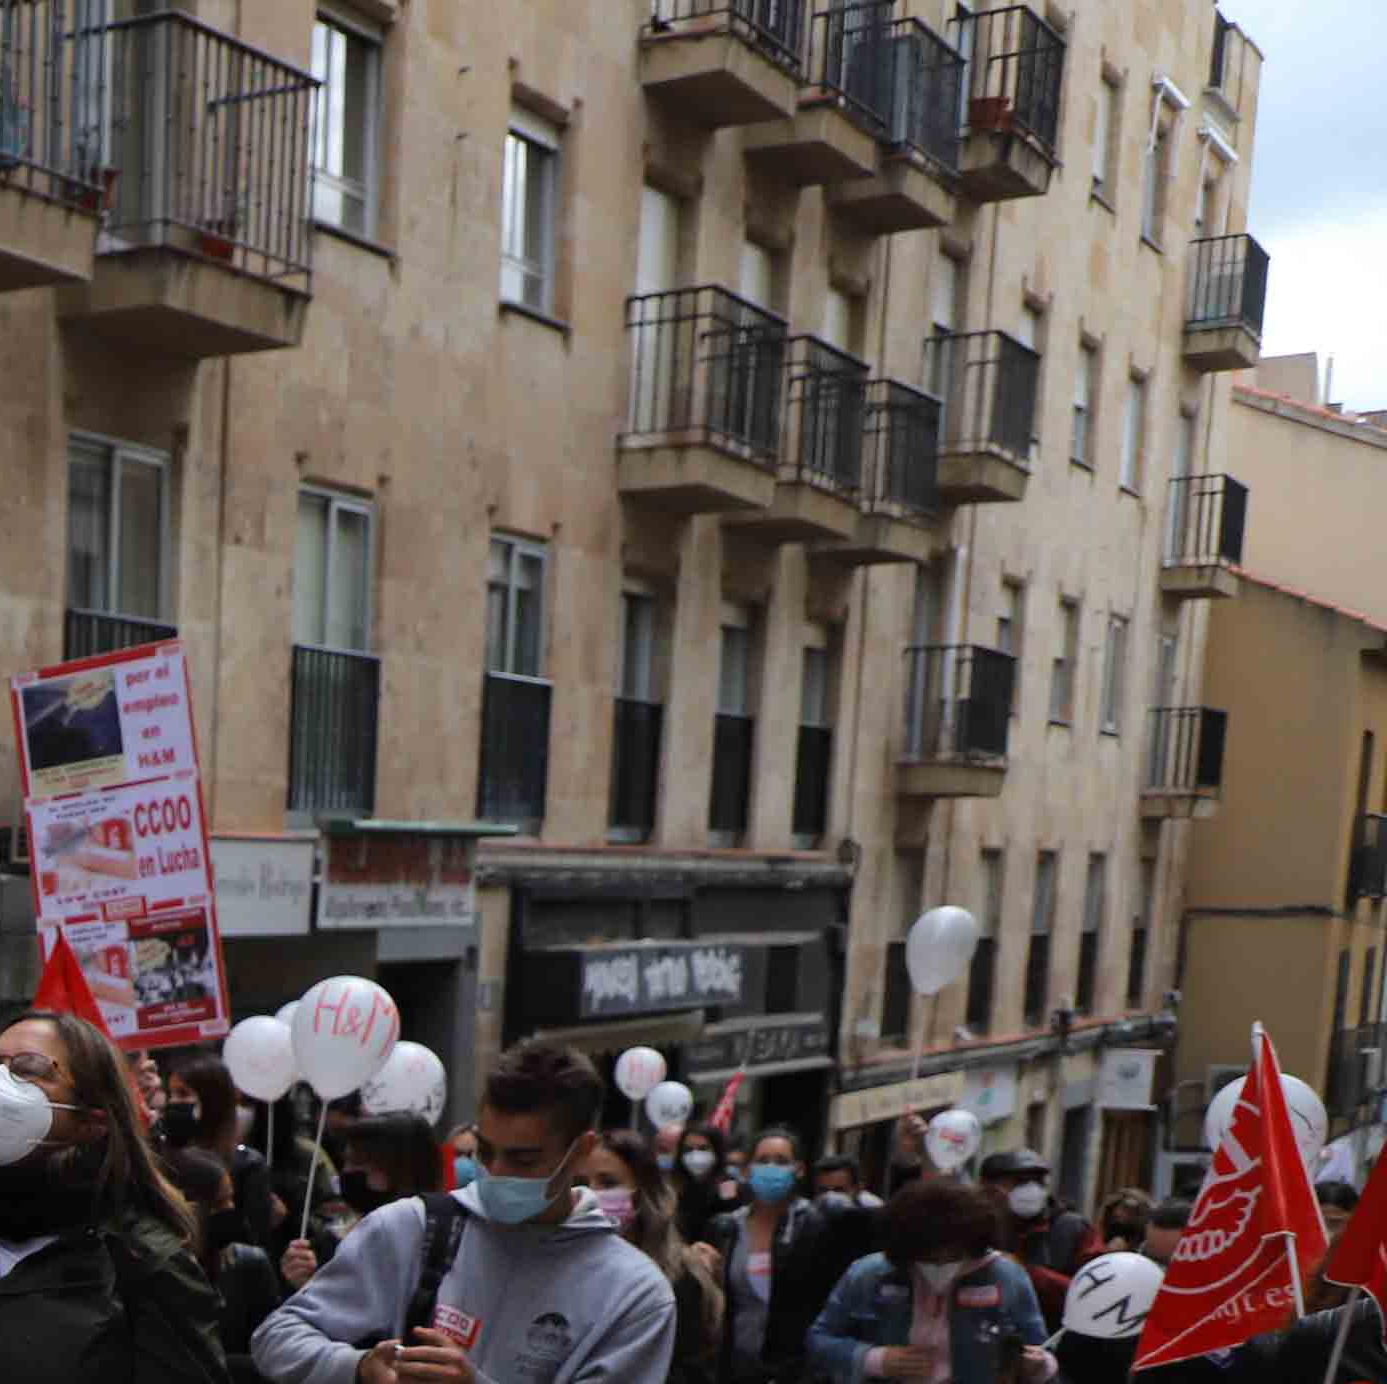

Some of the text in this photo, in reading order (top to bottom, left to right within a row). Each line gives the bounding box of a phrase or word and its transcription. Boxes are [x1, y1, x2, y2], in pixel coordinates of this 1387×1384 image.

[137, 748, 176, 769] H&M
[133, 794, 192, 838] CCOO
[138, 842, 201, 878] en Lucha
